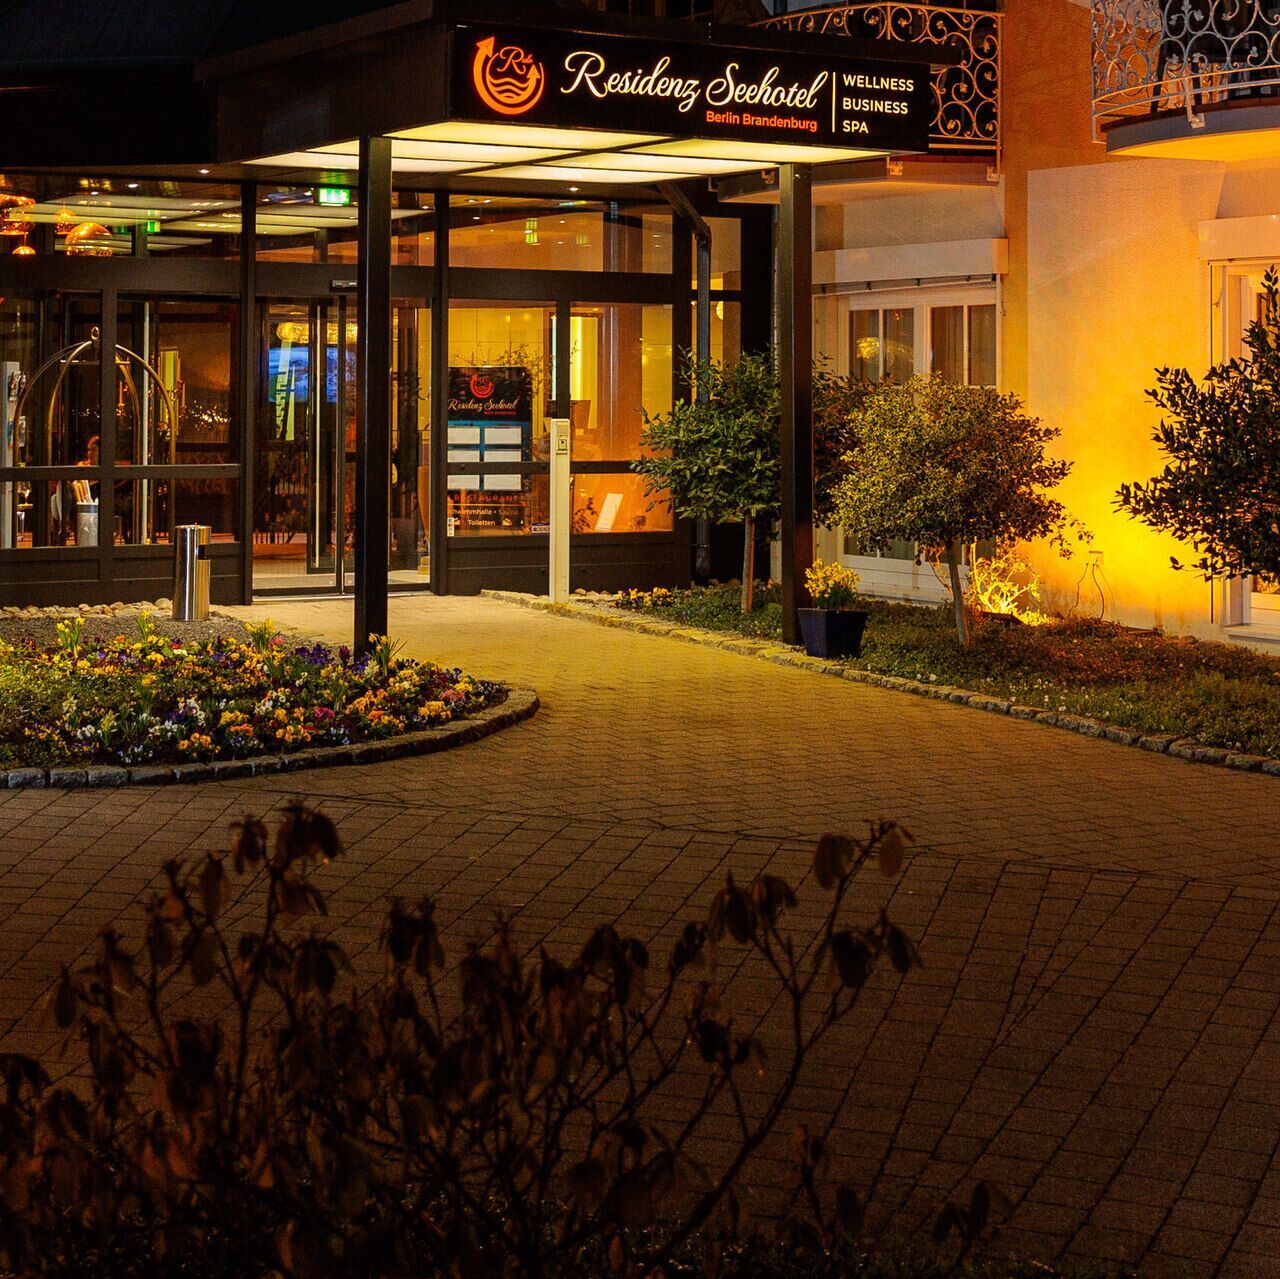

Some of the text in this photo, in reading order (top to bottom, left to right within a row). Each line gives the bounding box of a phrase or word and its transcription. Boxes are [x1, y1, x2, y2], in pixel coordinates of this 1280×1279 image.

[560, 51, 829, 113] Residenz Seehotel
[842, 73, 914, 92] WELLNESS
[842, 97, 909, 114] BUSINESS
[706, 110, 818, 133] Berlin Brandenburg
[842, 120, 869, 134] SPA
